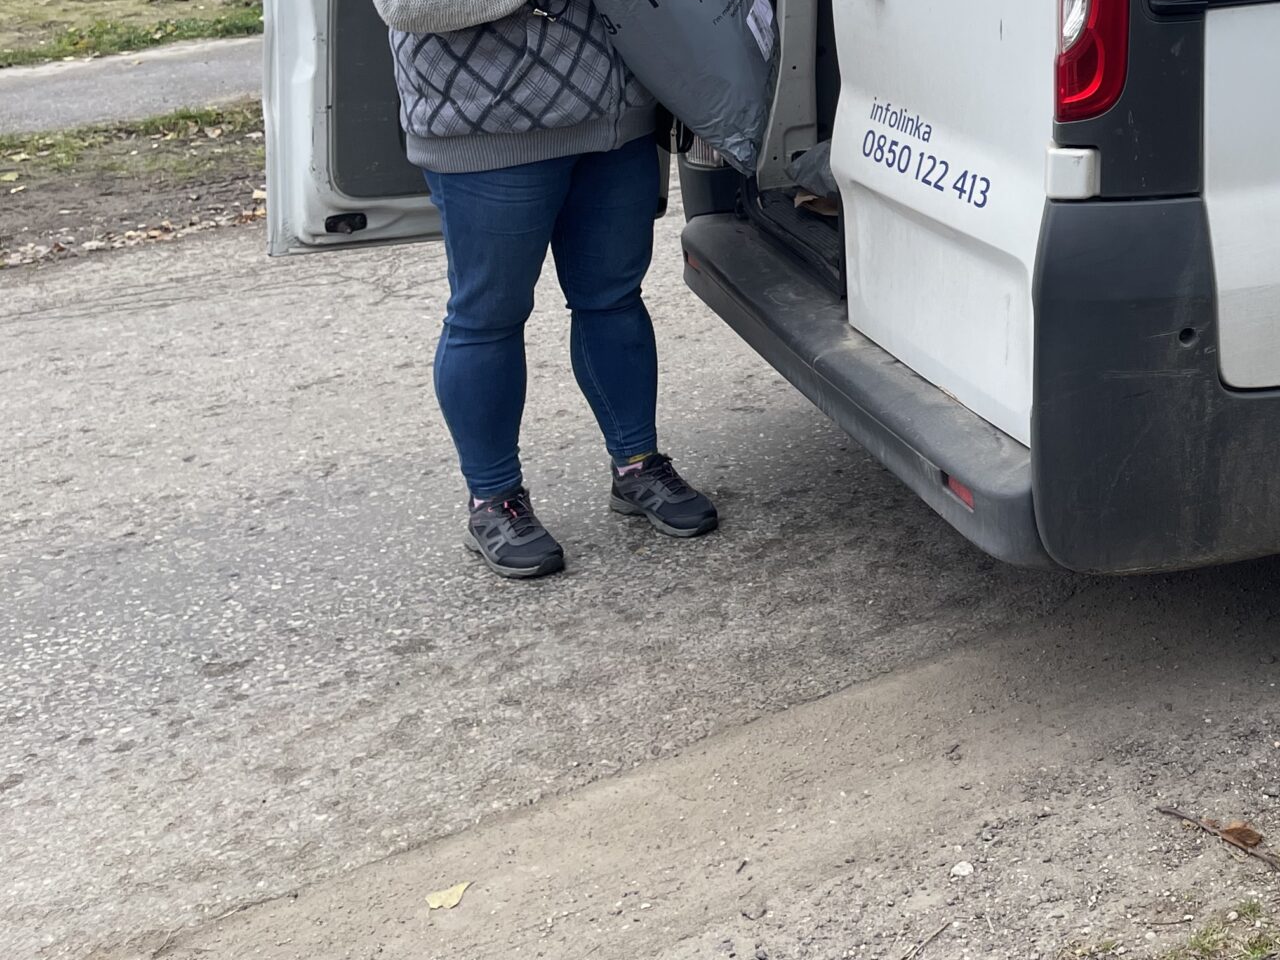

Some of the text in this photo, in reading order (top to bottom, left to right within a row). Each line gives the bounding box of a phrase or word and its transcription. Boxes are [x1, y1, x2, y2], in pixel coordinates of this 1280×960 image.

[870, 97, 932, 143] infolinka
[862, 129, 991, 208] 0850 122 413
